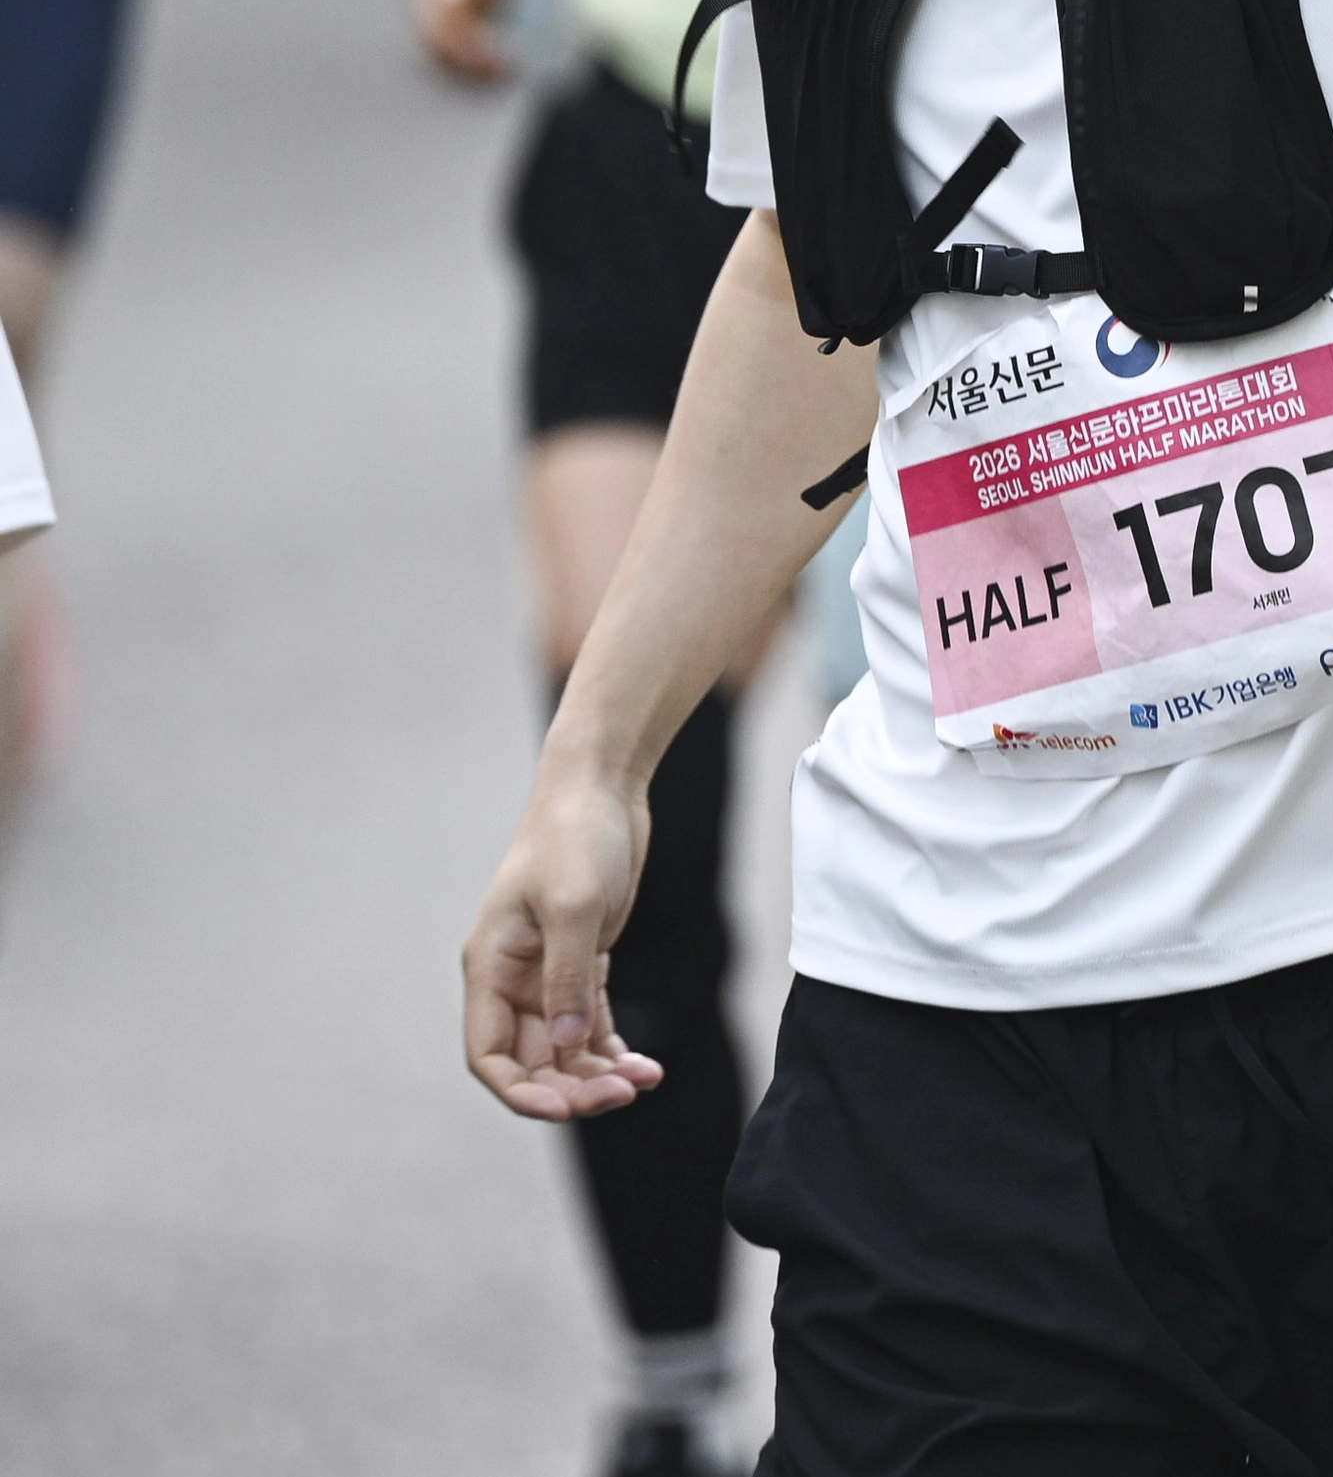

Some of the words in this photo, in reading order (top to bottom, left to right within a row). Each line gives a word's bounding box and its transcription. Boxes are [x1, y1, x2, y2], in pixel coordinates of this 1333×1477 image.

[928, 345, 1064, 420] 서울신문
[968, 446, 1021, 482] 2026
[1028, 362, 1298, 466] 서울신문하프마라톤대회
[978, 481, 1029, 510] SEOUL
[1032, 449, 1117, 494] SHINMUN
[1120, 433, 1175, 467] HALF
[1181, 396, 1306, 449] MARATHON
[936, 563, 1073, 650] HALF
[1253, 587, 1292, 611] 서재민
[1165, 689, 1213, 722] IBK
[1212, 666, 1297, 705] 기업은행
